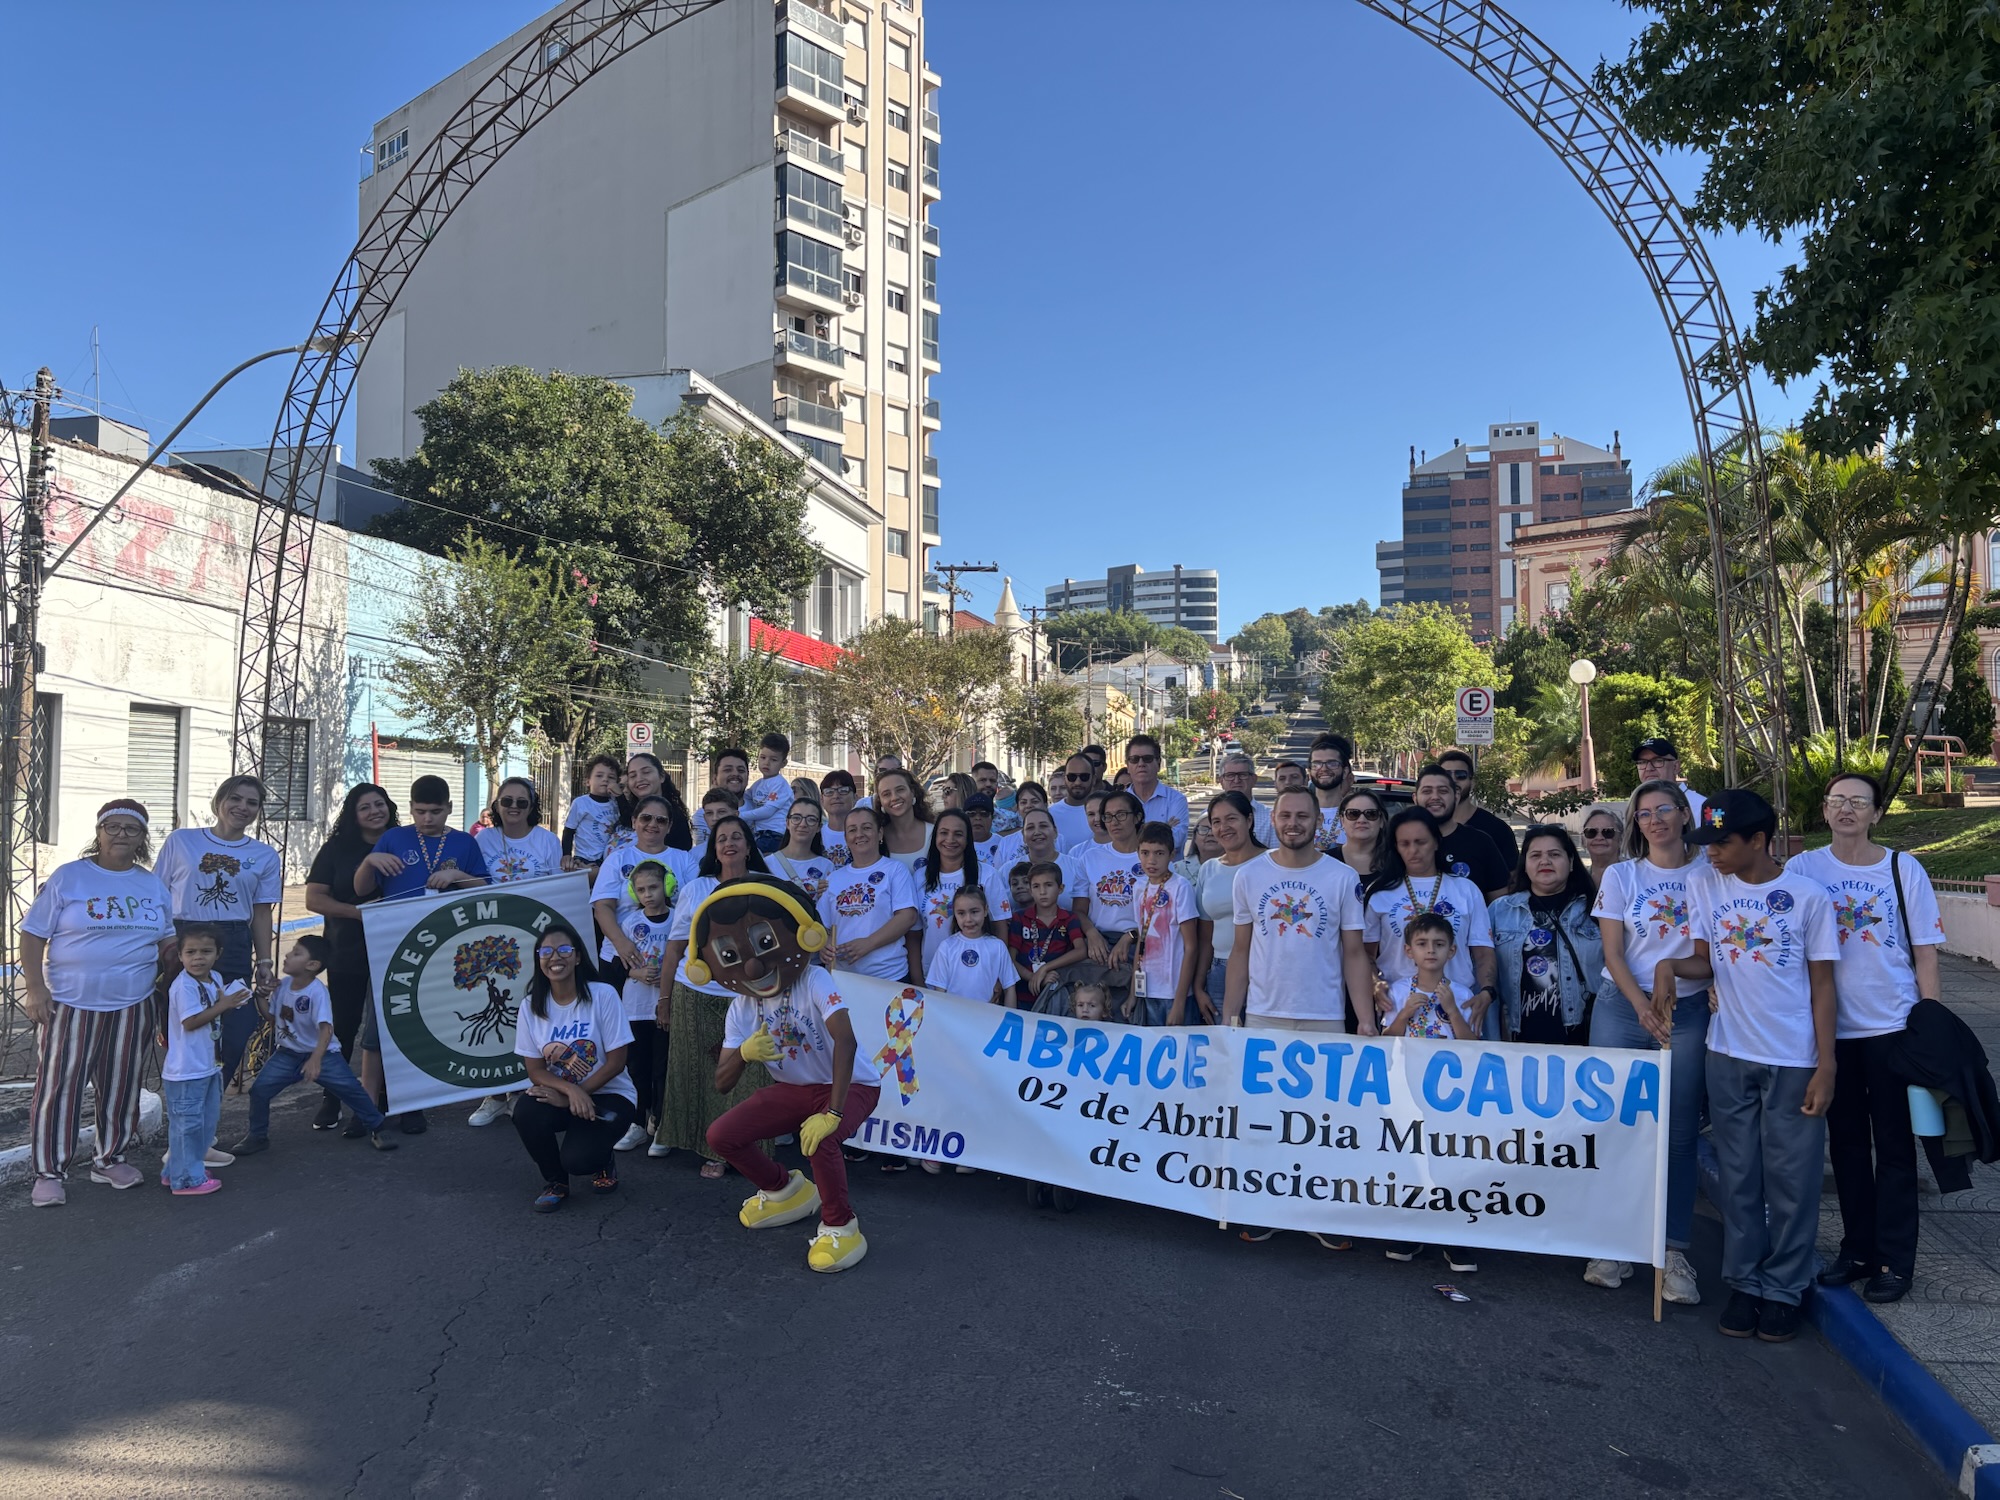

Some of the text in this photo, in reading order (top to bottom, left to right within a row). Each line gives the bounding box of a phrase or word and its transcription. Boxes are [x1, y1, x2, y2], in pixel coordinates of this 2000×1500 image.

[1469, 693, 1482, 711] E
[636, 727, 645, 739] E
[1101, 883, 1131, 895] AMA
[1645, 886, 1658, 897] AS
[1826, 884, 1840, 895] AS
[1841, 880, 1876, 892] PEÇAS
[1874, 884, 1888, 899] SE
[86, 896, 158, 921] CAPS
[842, 893, 870, 906] AMA
[1258, 892, 1271, 916] AMOR
[1270, 884, 1280, 895] AS
[1281, 880, 1307, 890] PEÇAS
[1307, 886, 1318, 898] SE
[1315, 896, 1328, 938] ENCAIXAM
[1632, 893, 1648, 921] AMOR
[1720, 902, 1731, 914] AS
[1733, 898, 1766, 911] PEÇAS
[1389, 900, 1404, 919] AMOR
[1390, 921, 1402, 937] COM
[1635, 921, 1648, 939] COM
[388, 929, 438, 1016] MÃES
[451, 900, 499, 927] EM
[550, 1020, 590, 1041] MÃE
[447, 1061, 525, 1079] TAQUARA
[983, 1012, 1659, 1126] ABRACE ESTA CAUSA
[1018, 1076, 1067, 1110] 02
[1080, 1092, 1129, 1125] de
[1138, 1102, 1240, 1141] Abril
[1279, 1110, 1360, 1151] Dia
[1377, 1117, 1600, 1170] Mundial
[848, 1117, 965, 1159] TISMO
[1089, 1139, 1546, 1223] de Conscientização
